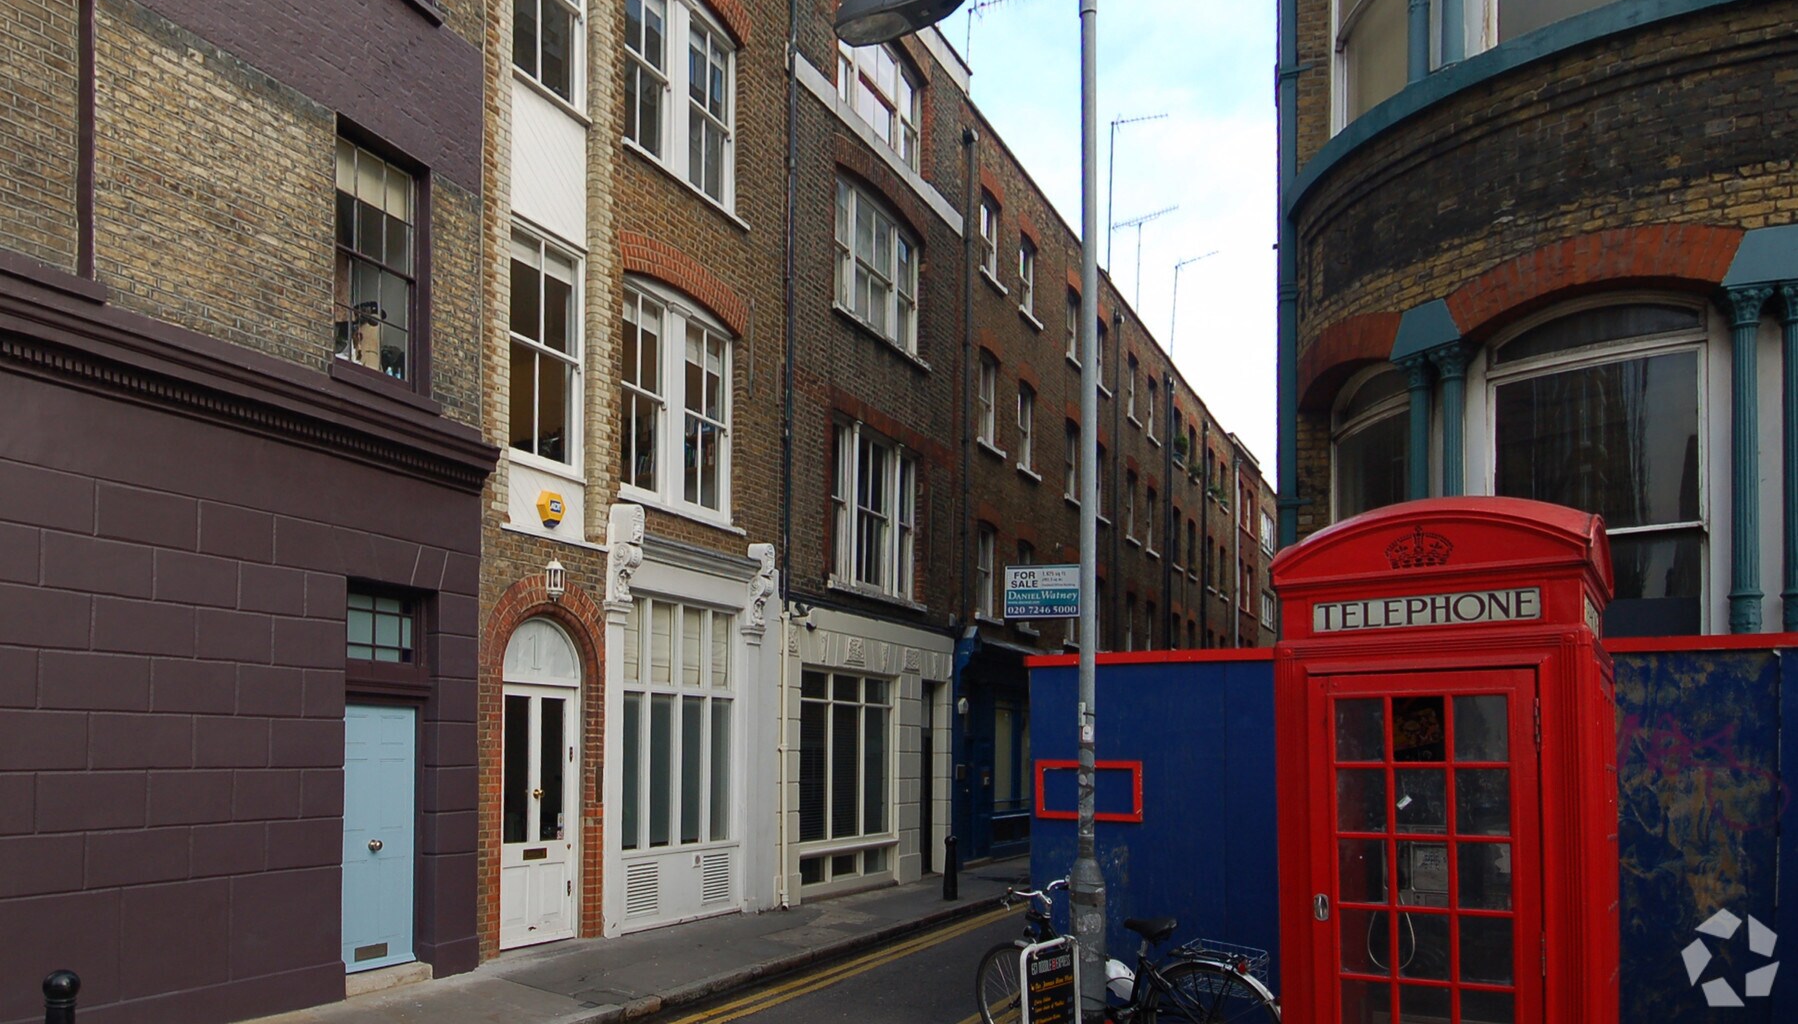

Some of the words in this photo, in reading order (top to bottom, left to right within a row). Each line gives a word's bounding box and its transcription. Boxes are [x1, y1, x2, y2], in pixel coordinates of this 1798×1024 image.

[1013, 571, 1036, 579] FOR
[1011, 580, 1038, 588] SALE
[1008, 591, 1040, 600] DANIEL
[1041, 590, 1077, 601] Watney
[1008, 606, 1025, 614] 020
[1029, 606, 1051, 614] 7246
[1053, 605, 1077, 613] 5000
[1317, 589, 1537, 631] TELEPHONE
